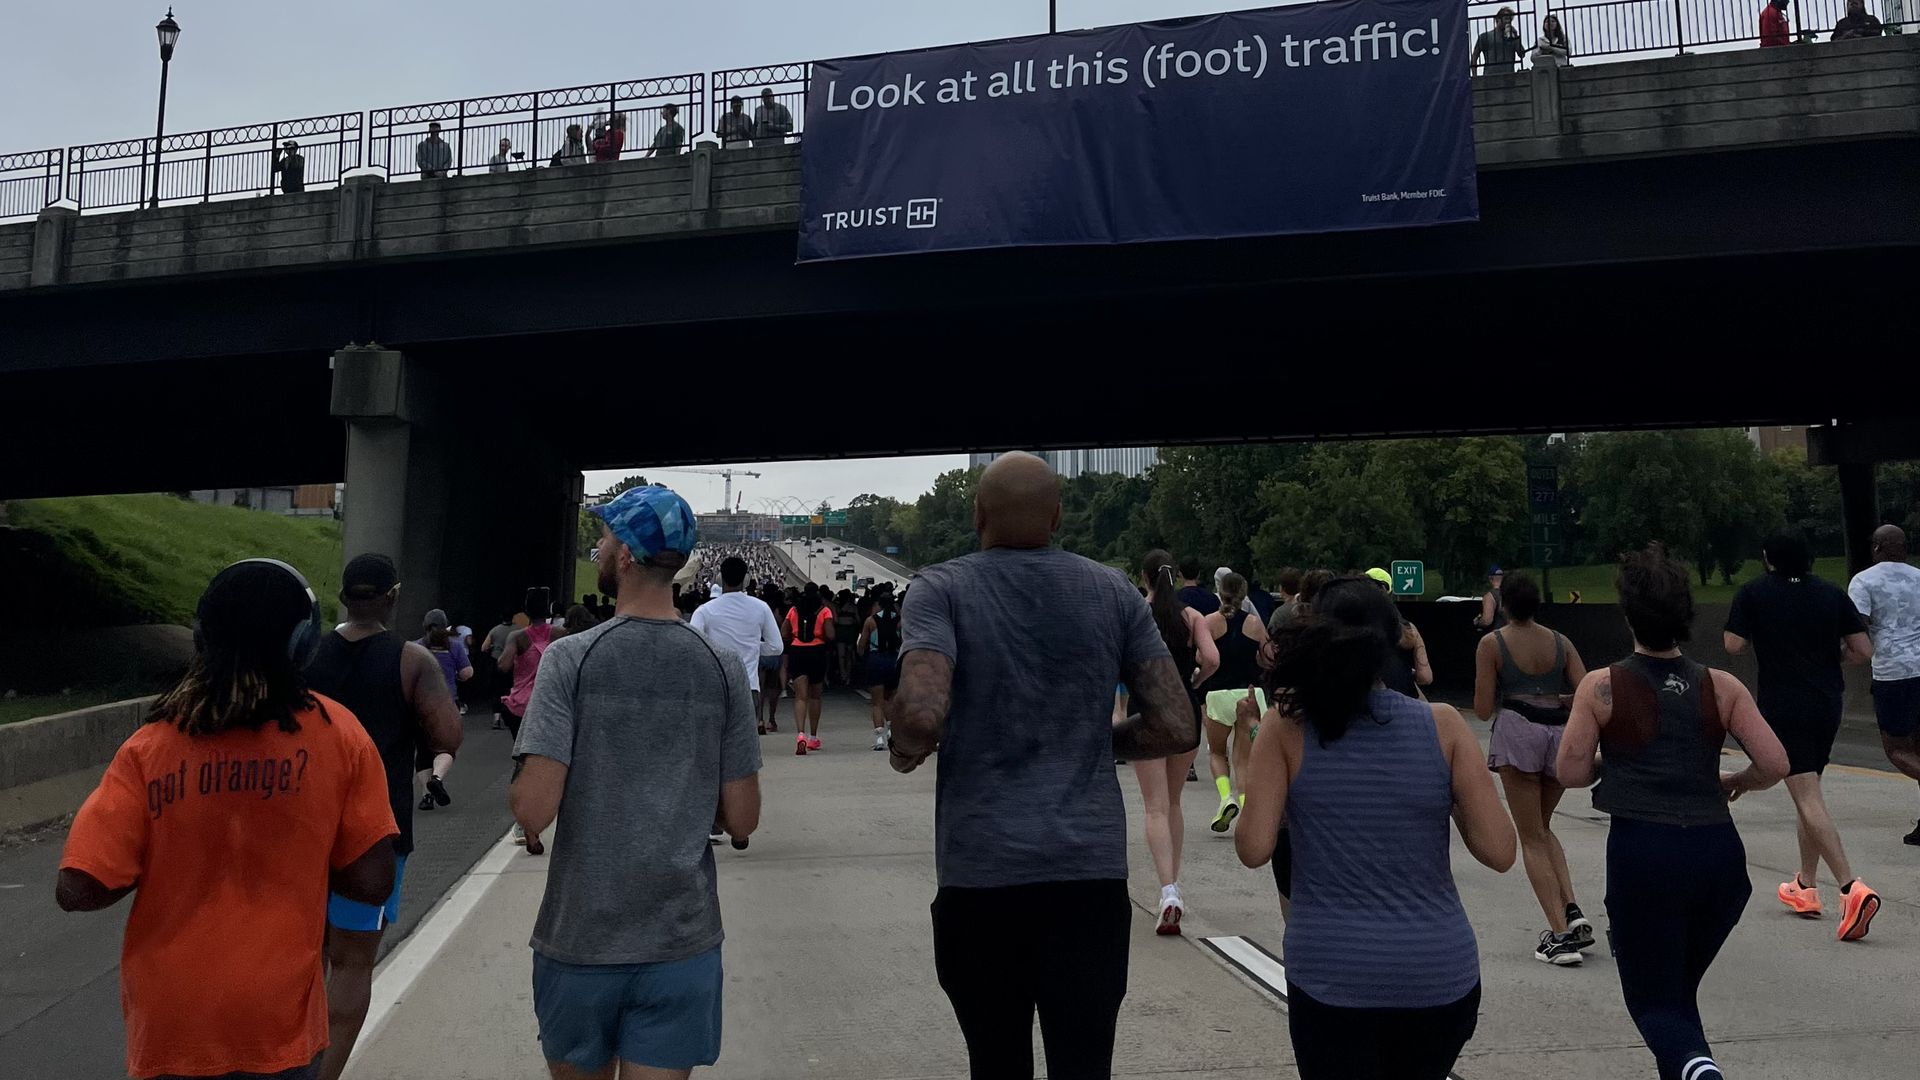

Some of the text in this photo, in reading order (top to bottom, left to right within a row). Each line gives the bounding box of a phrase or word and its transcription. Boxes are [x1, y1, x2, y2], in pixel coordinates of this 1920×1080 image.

[826, 18, 1440, 112] Look at all this (foot) traffic!
[1361, 194, 1380, 202] Truist
[1381, 192, 1400, 201] Bank,
[1400, 191, 1428, 199] Member
[822, 206, 902, 231] TRUIST
[1533, 513, 1559, 525] MILE
[1397, 566, 1418, 575] EXIT
[147, 749, 309, 820] got orange?
